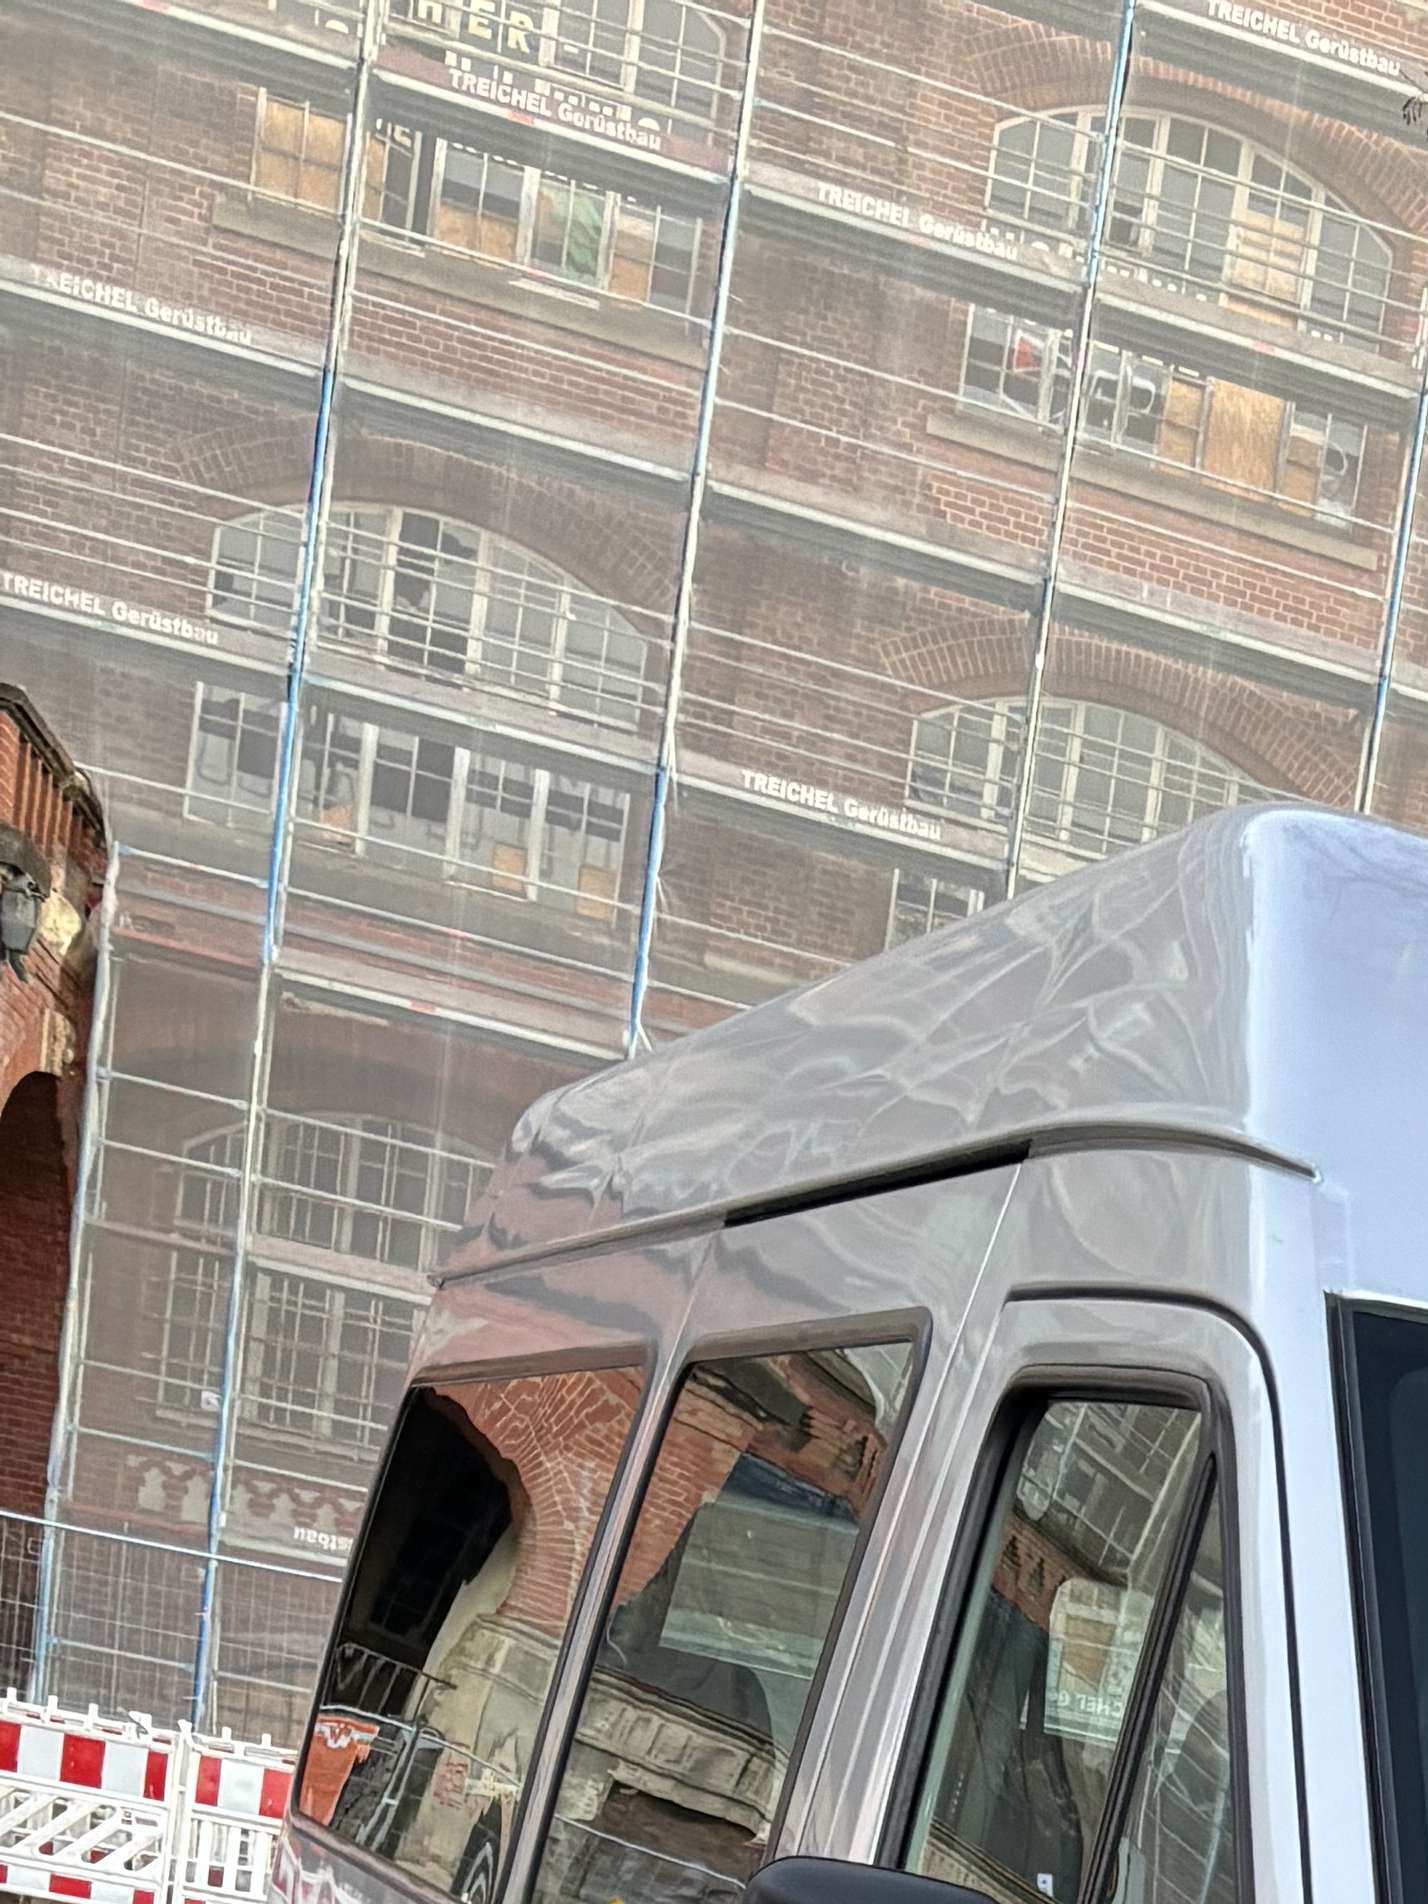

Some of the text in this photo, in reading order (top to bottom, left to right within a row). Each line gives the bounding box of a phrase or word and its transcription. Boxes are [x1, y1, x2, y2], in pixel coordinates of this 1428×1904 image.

[1206, 0, 1400, 77] TREICHEL Gerüstbau
[448, 67, 662, 151] TREICHEL Gerüstbau
[815, 180, 1017, 260] TREICHEL Gerüstbau
[30, 262, 253, 345] TREICHEL Gerüstbau
[1, 570, 220, 646] TREICHEL Gerüstbau
[741, 769, 942, 841] TREICHEL Gerüstbau
